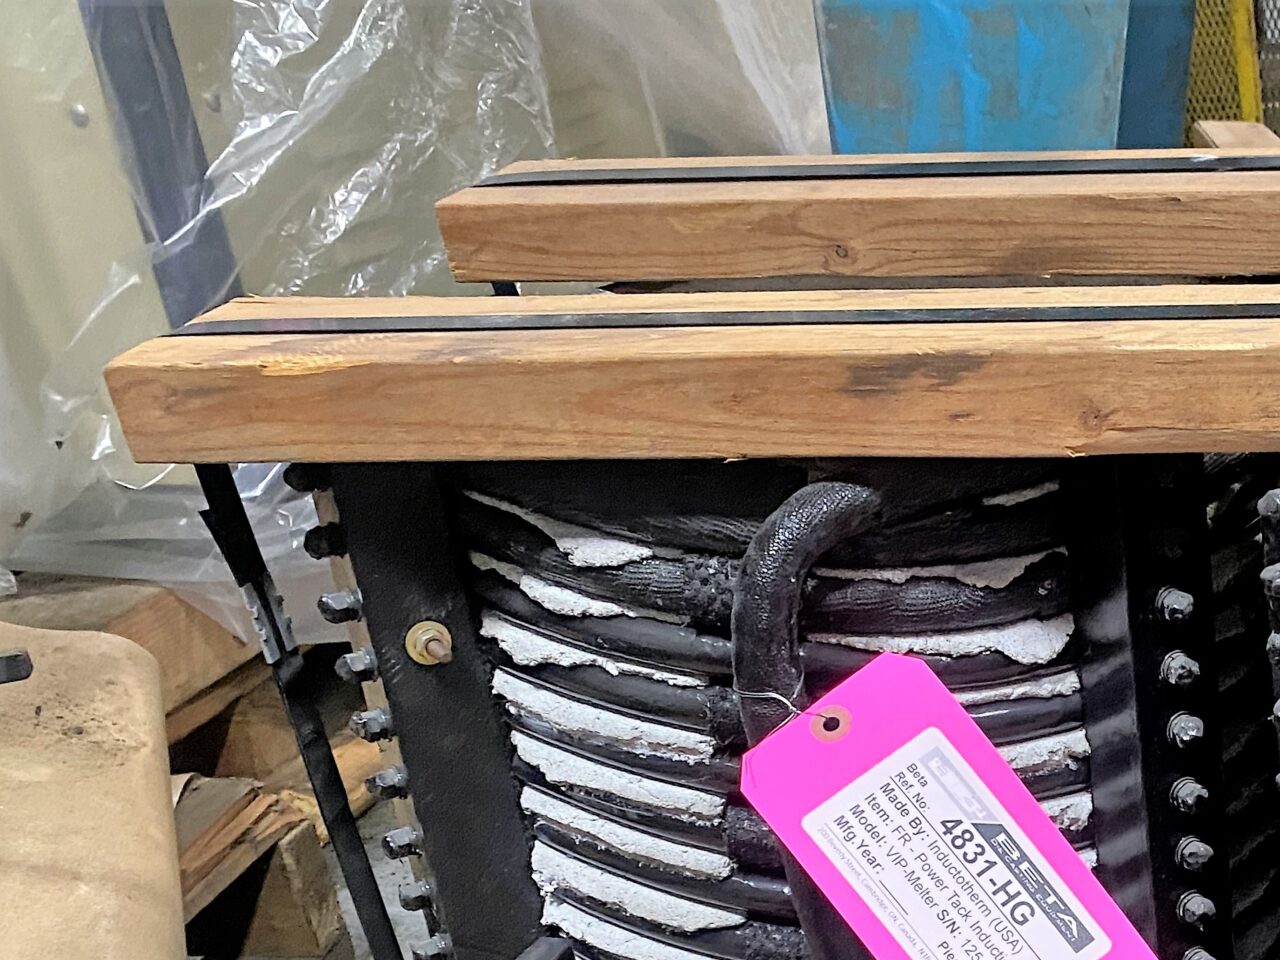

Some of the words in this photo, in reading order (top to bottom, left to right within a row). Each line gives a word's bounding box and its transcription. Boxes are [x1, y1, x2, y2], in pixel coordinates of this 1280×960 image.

[893, 769, 916, 794] Ref.
[910, 791, 932, 813] No:
[905, 761, 930, 788] Beta
[830, 812, 887, 877] Mfg.Year:
[847, 801, 890, 849] Model:
[883, 844, 941, 911] VIP-Melter
[934, 906, 964, 939] S/N:
[863, 791, 896, 827] Item:
[890, 823, 913, 847] FR
[913, 851, 951, 894] Power
[944, 889, 975, 923] Tack
[878, 780, 913, 819] Made
[904, 815, 932, 843] By:
[926, 838, 995, 918] Inductotherm
[986, 914, 1025, 957] (USA)
[935, 810, 1039, 929] 4831-HG
[993, 831, 1085, 939] BETA
